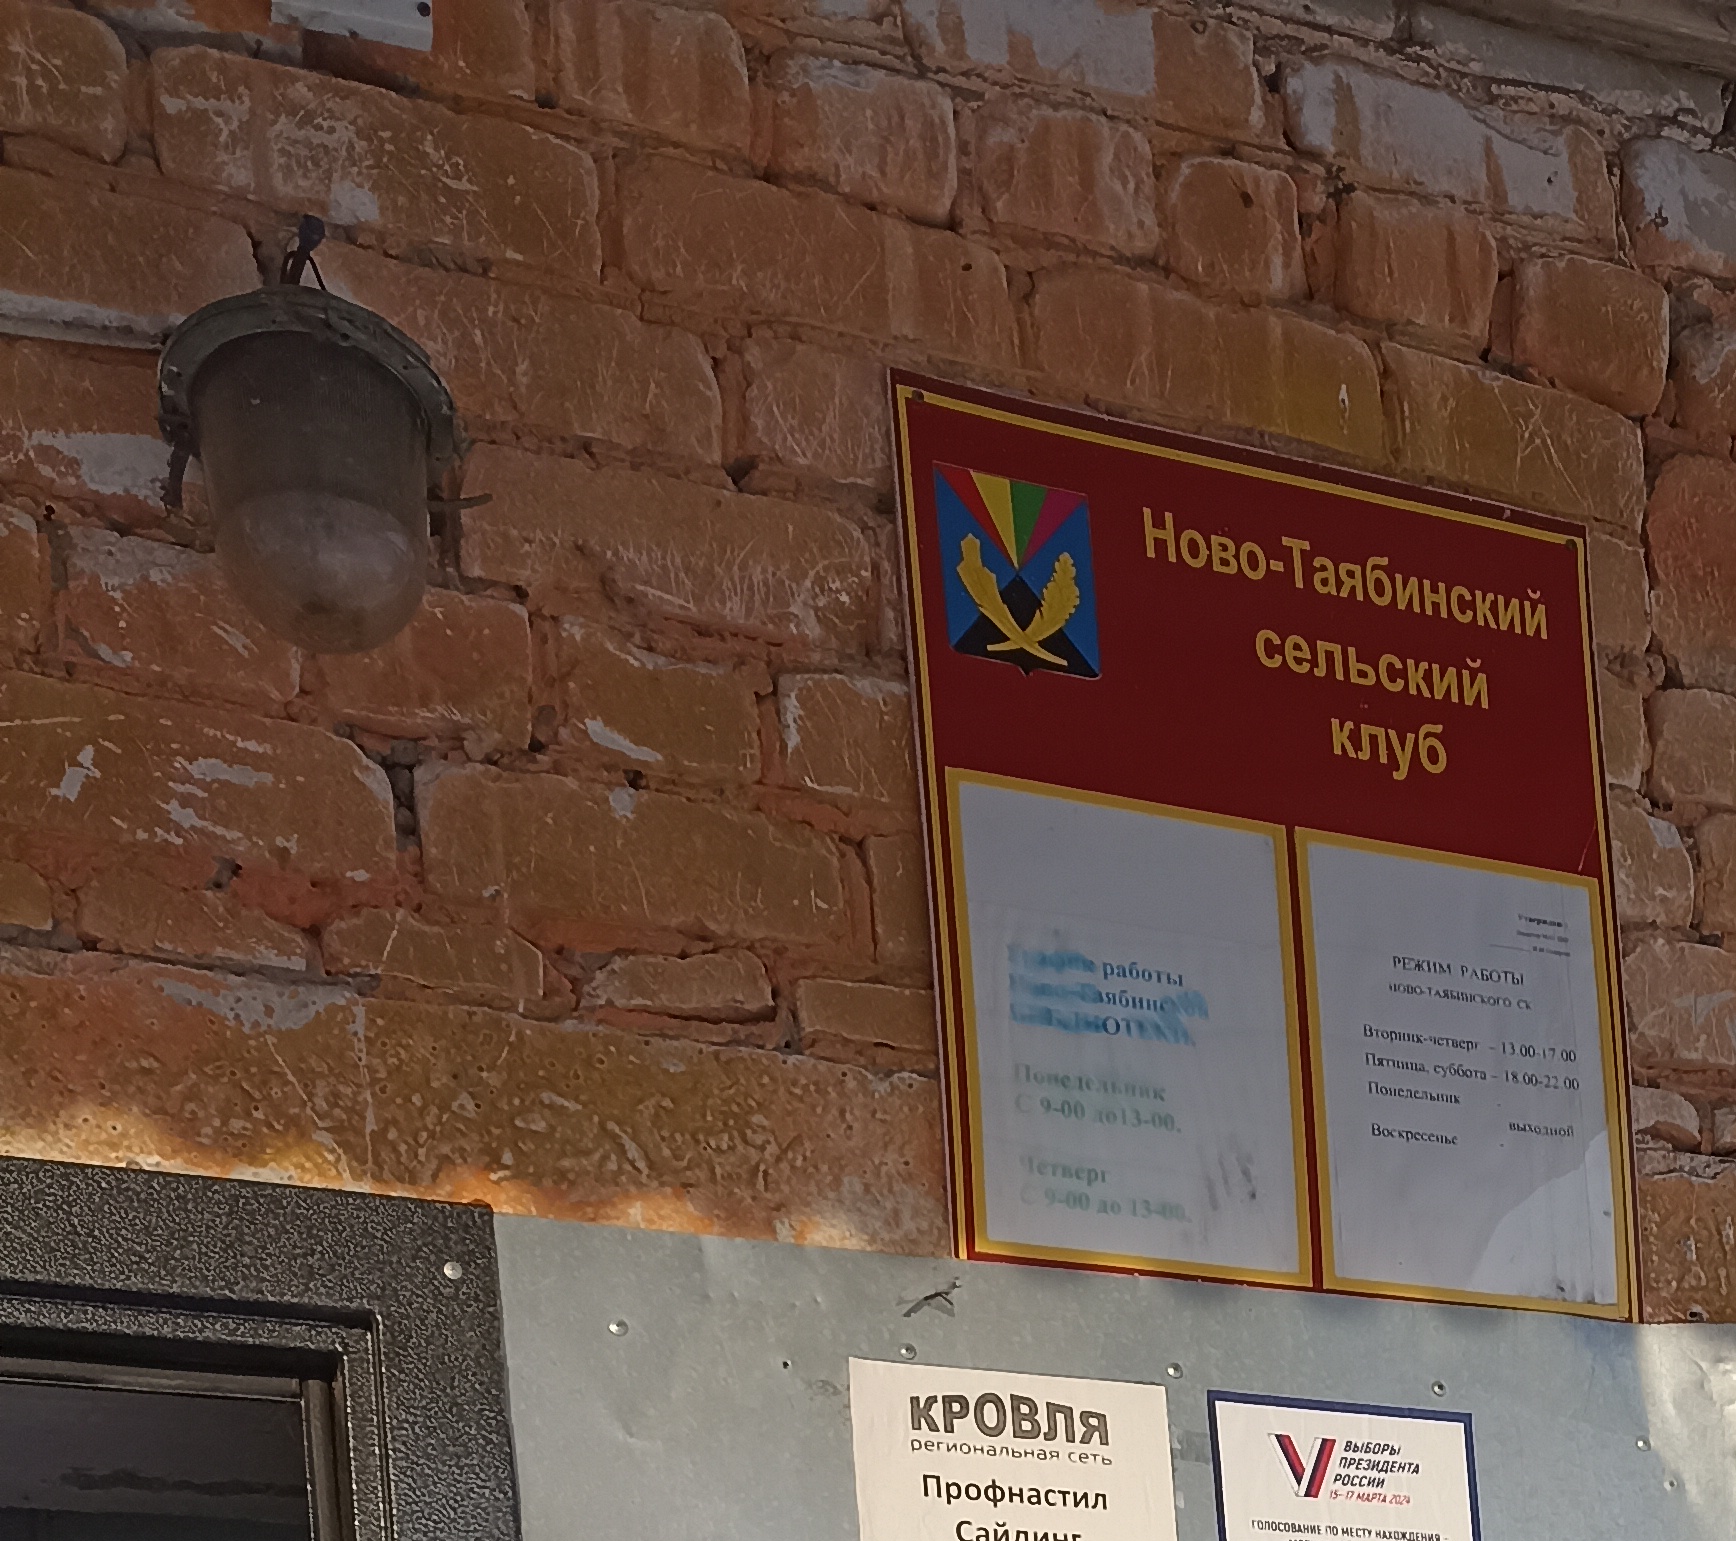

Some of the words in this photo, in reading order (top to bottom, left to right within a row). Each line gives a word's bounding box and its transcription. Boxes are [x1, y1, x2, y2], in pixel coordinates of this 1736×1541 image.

[1142, 506, 1549, 641] Ново-Таябинский
[1255, 628, 1490, 710] сельский
[1330, 717, 1447, 781] клуб
[1102, 962, 1183, 987] работы
[1393, 955, 1452, 976] РЕЖИМ
[1460, 964, 1524, 986] РАБОТЫ
[1368, 1081, 1461, 1104] Понедельник
[1371, 1123, 1459, 1145] Воскресенье
[909, 1392, 1110, 1446] КРОВЛЯ
[910, 1437, 1060, 1462] региональная
[1068, 1448, 1113, 1466] сеть
[1343, 1440, 1401, 1456] ВЫБОРЫ
[1339, 1457, 1420, 1475] ПРЕЗИДЕНТА
[921, 1473, 1108, 1511] Профнастил
[1333, 1473, 1385, 1489] РОССИИ
[1356, 1492, 1387, 1503] МАРТА
[1251, 1520, 1321, 1535] ГОЛОСОВАНИЕ
[1325, 1525, 1338, 1536] ПО
[1341, 1527, 1372, 1538] МЕСТУ
